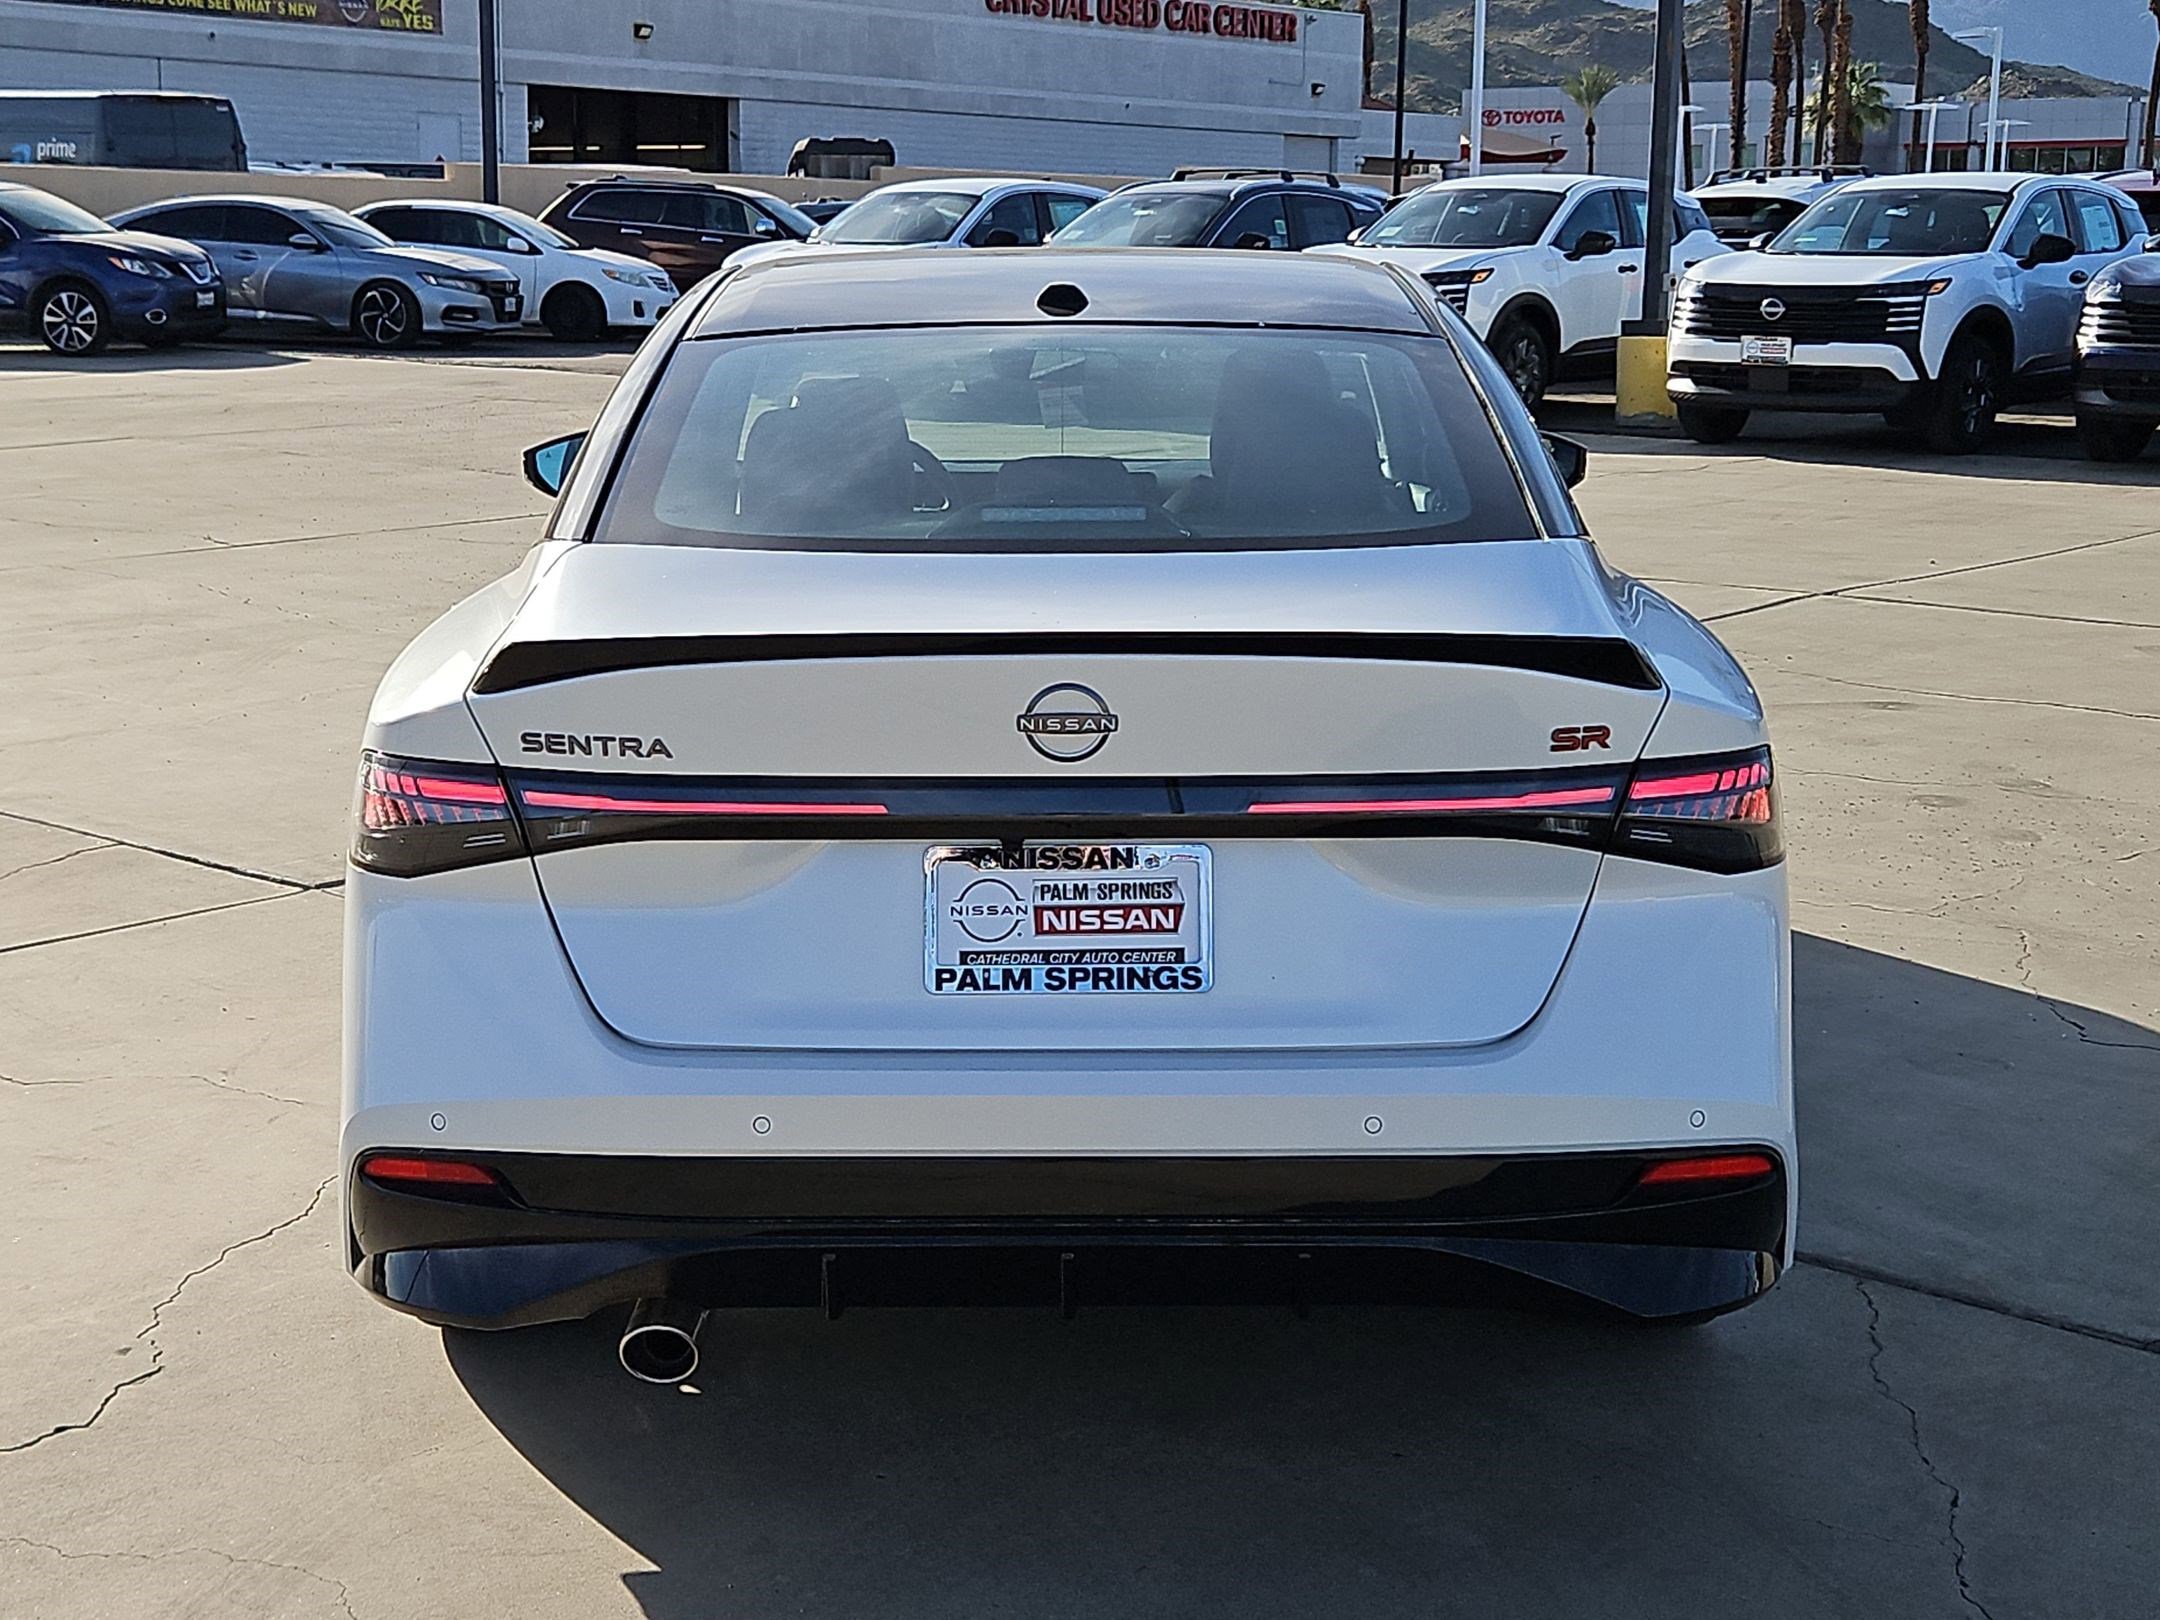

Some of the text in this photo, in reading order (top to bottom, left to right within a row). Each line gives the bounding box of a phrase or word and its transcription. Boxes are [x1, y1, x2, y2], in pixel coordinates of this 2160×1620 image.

[288, 2, 318, 17] NEW
[402, 13, 434, 30] YES
[1097, 0, 1161, 28] USED
[1163, 0, 1212, 33] CAR
[1213, 4, 1298, 42] CENTER
[1503, 110, 1565, 124] TOYOTA
[37, 137, 77, 161] prime
[1020, 718, 1116, 731] NISSAN
[520, 732, 673, 759] SENTRA
[1550, 724, 1611, 752] SR
[1000, 846, 1134, 870] NISSAN
[1040, 881, 1173, 901] PALM SPRINGS
[950, 905, 1028, 916] NISSAN
[1042, 908, 1175, 931] NISSAN
[967, 951, 1176, 965] CATHEDRAL CITY AUTO CENTER
[935, 965, 1203, 991] PALM SPRINGS
